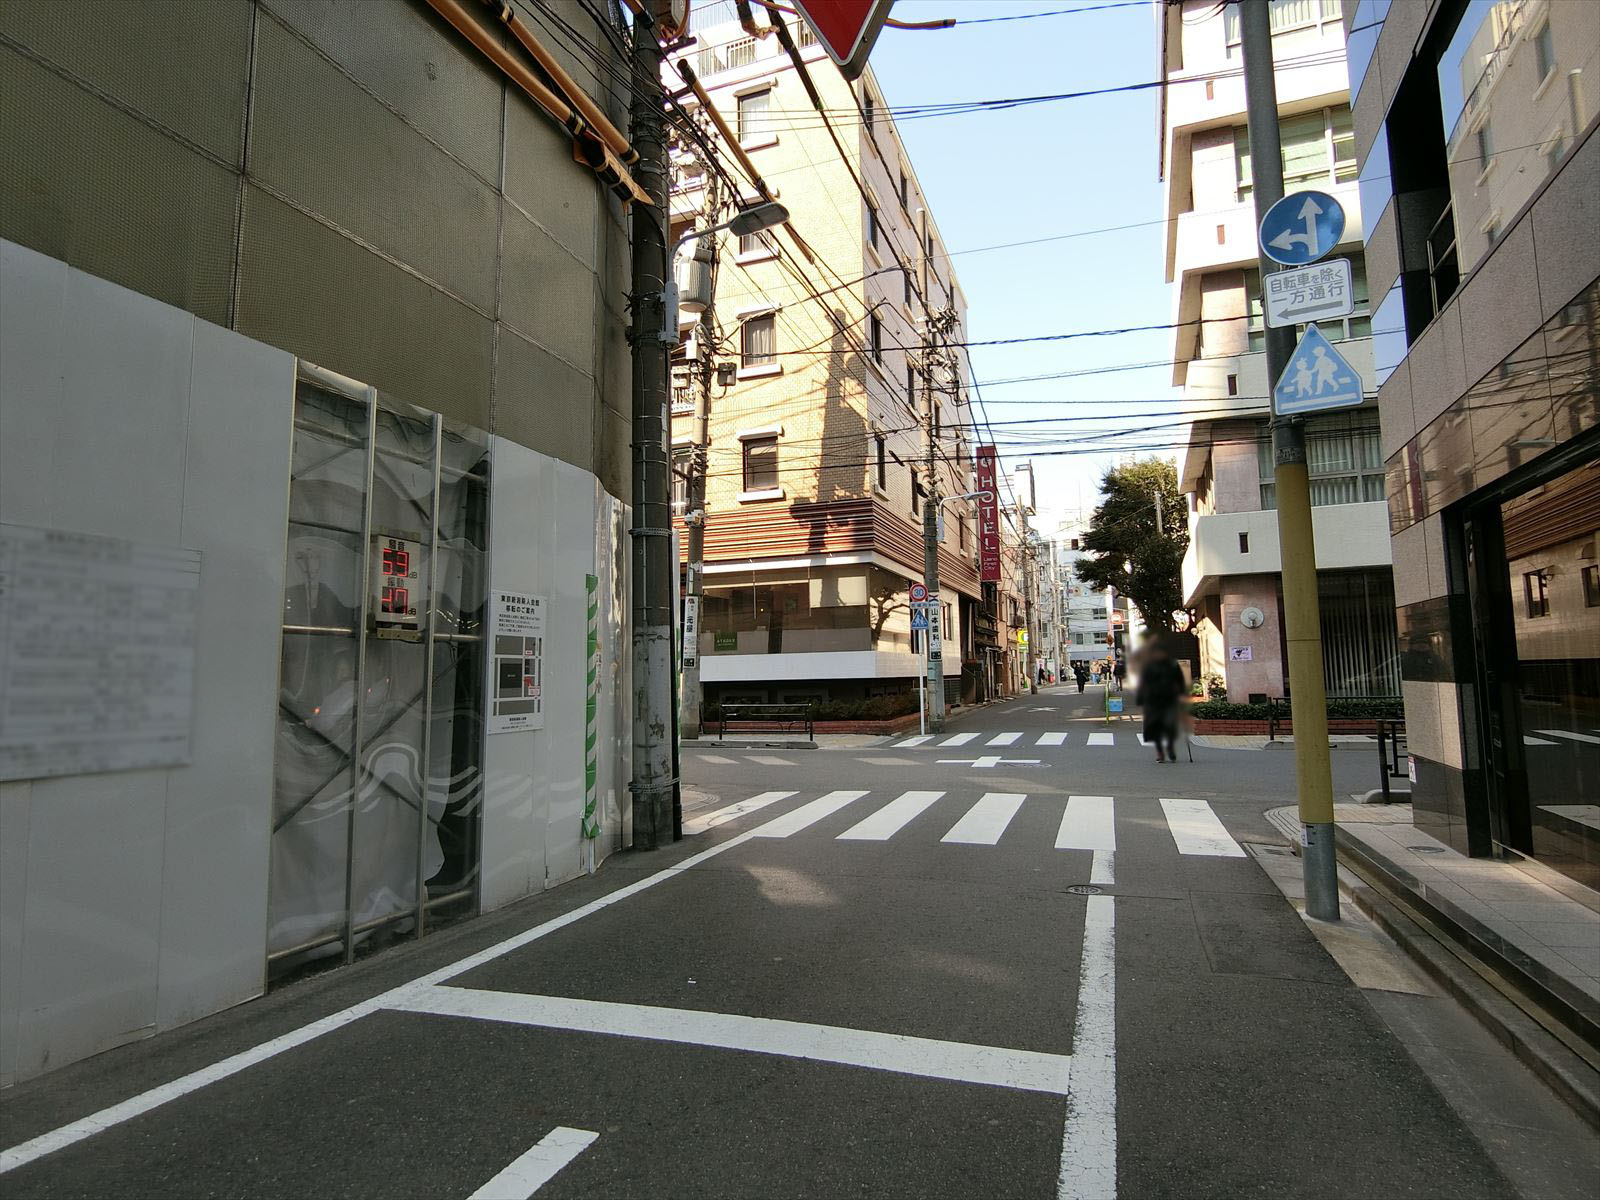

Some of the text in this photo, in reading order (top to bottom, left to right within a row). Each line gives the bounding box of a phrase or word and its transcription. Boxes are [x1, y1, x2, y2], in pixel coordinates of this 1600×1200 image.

[1271, 267, 1344, 293] 自転車を除く
[1271, 281, 1345, 305] 一方通行
[981, 475, 996, 550] HOTEL
[914, 588, 925, 597] 30
[408, 607, 417, 615] dB
[930, 607, 940, 642] 山本歯科
